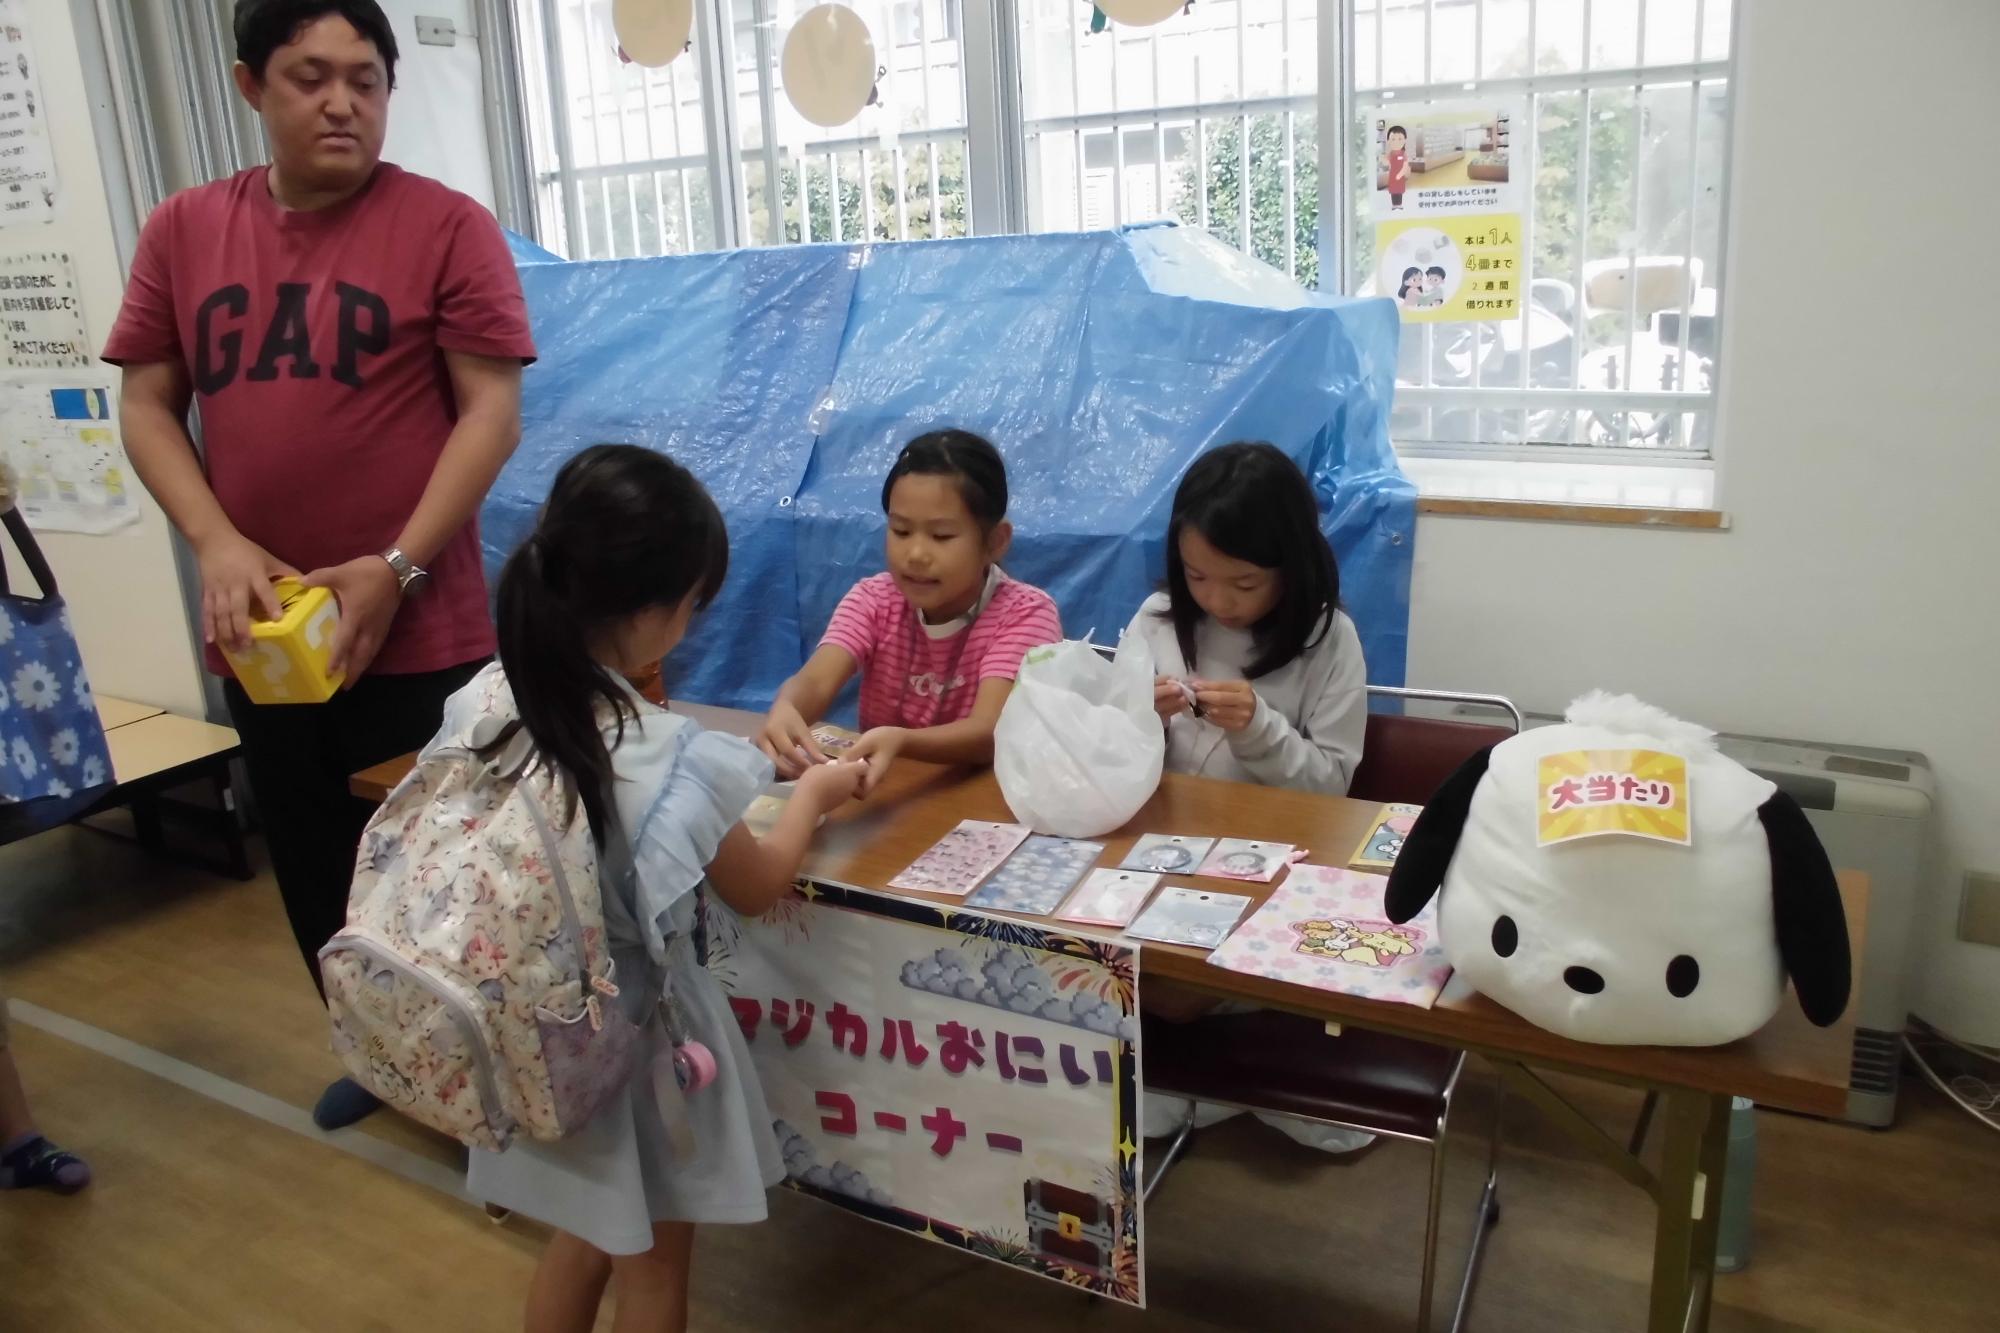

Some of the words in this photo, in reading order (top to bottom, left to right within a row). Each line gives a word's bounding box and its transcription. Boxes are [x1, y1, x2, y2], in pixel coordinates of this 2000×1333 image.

[1465, 228, 1512, 246] 本は1人
[1466, 254, 1513, 271] 4冊まで
[1466, 299, 1514, 309] 借りれます
[196, 280, 390, 396] GAP
[1552, 775, 1670, 809] 大当たり
[815, 1090, 1022, 1157] コーナー
